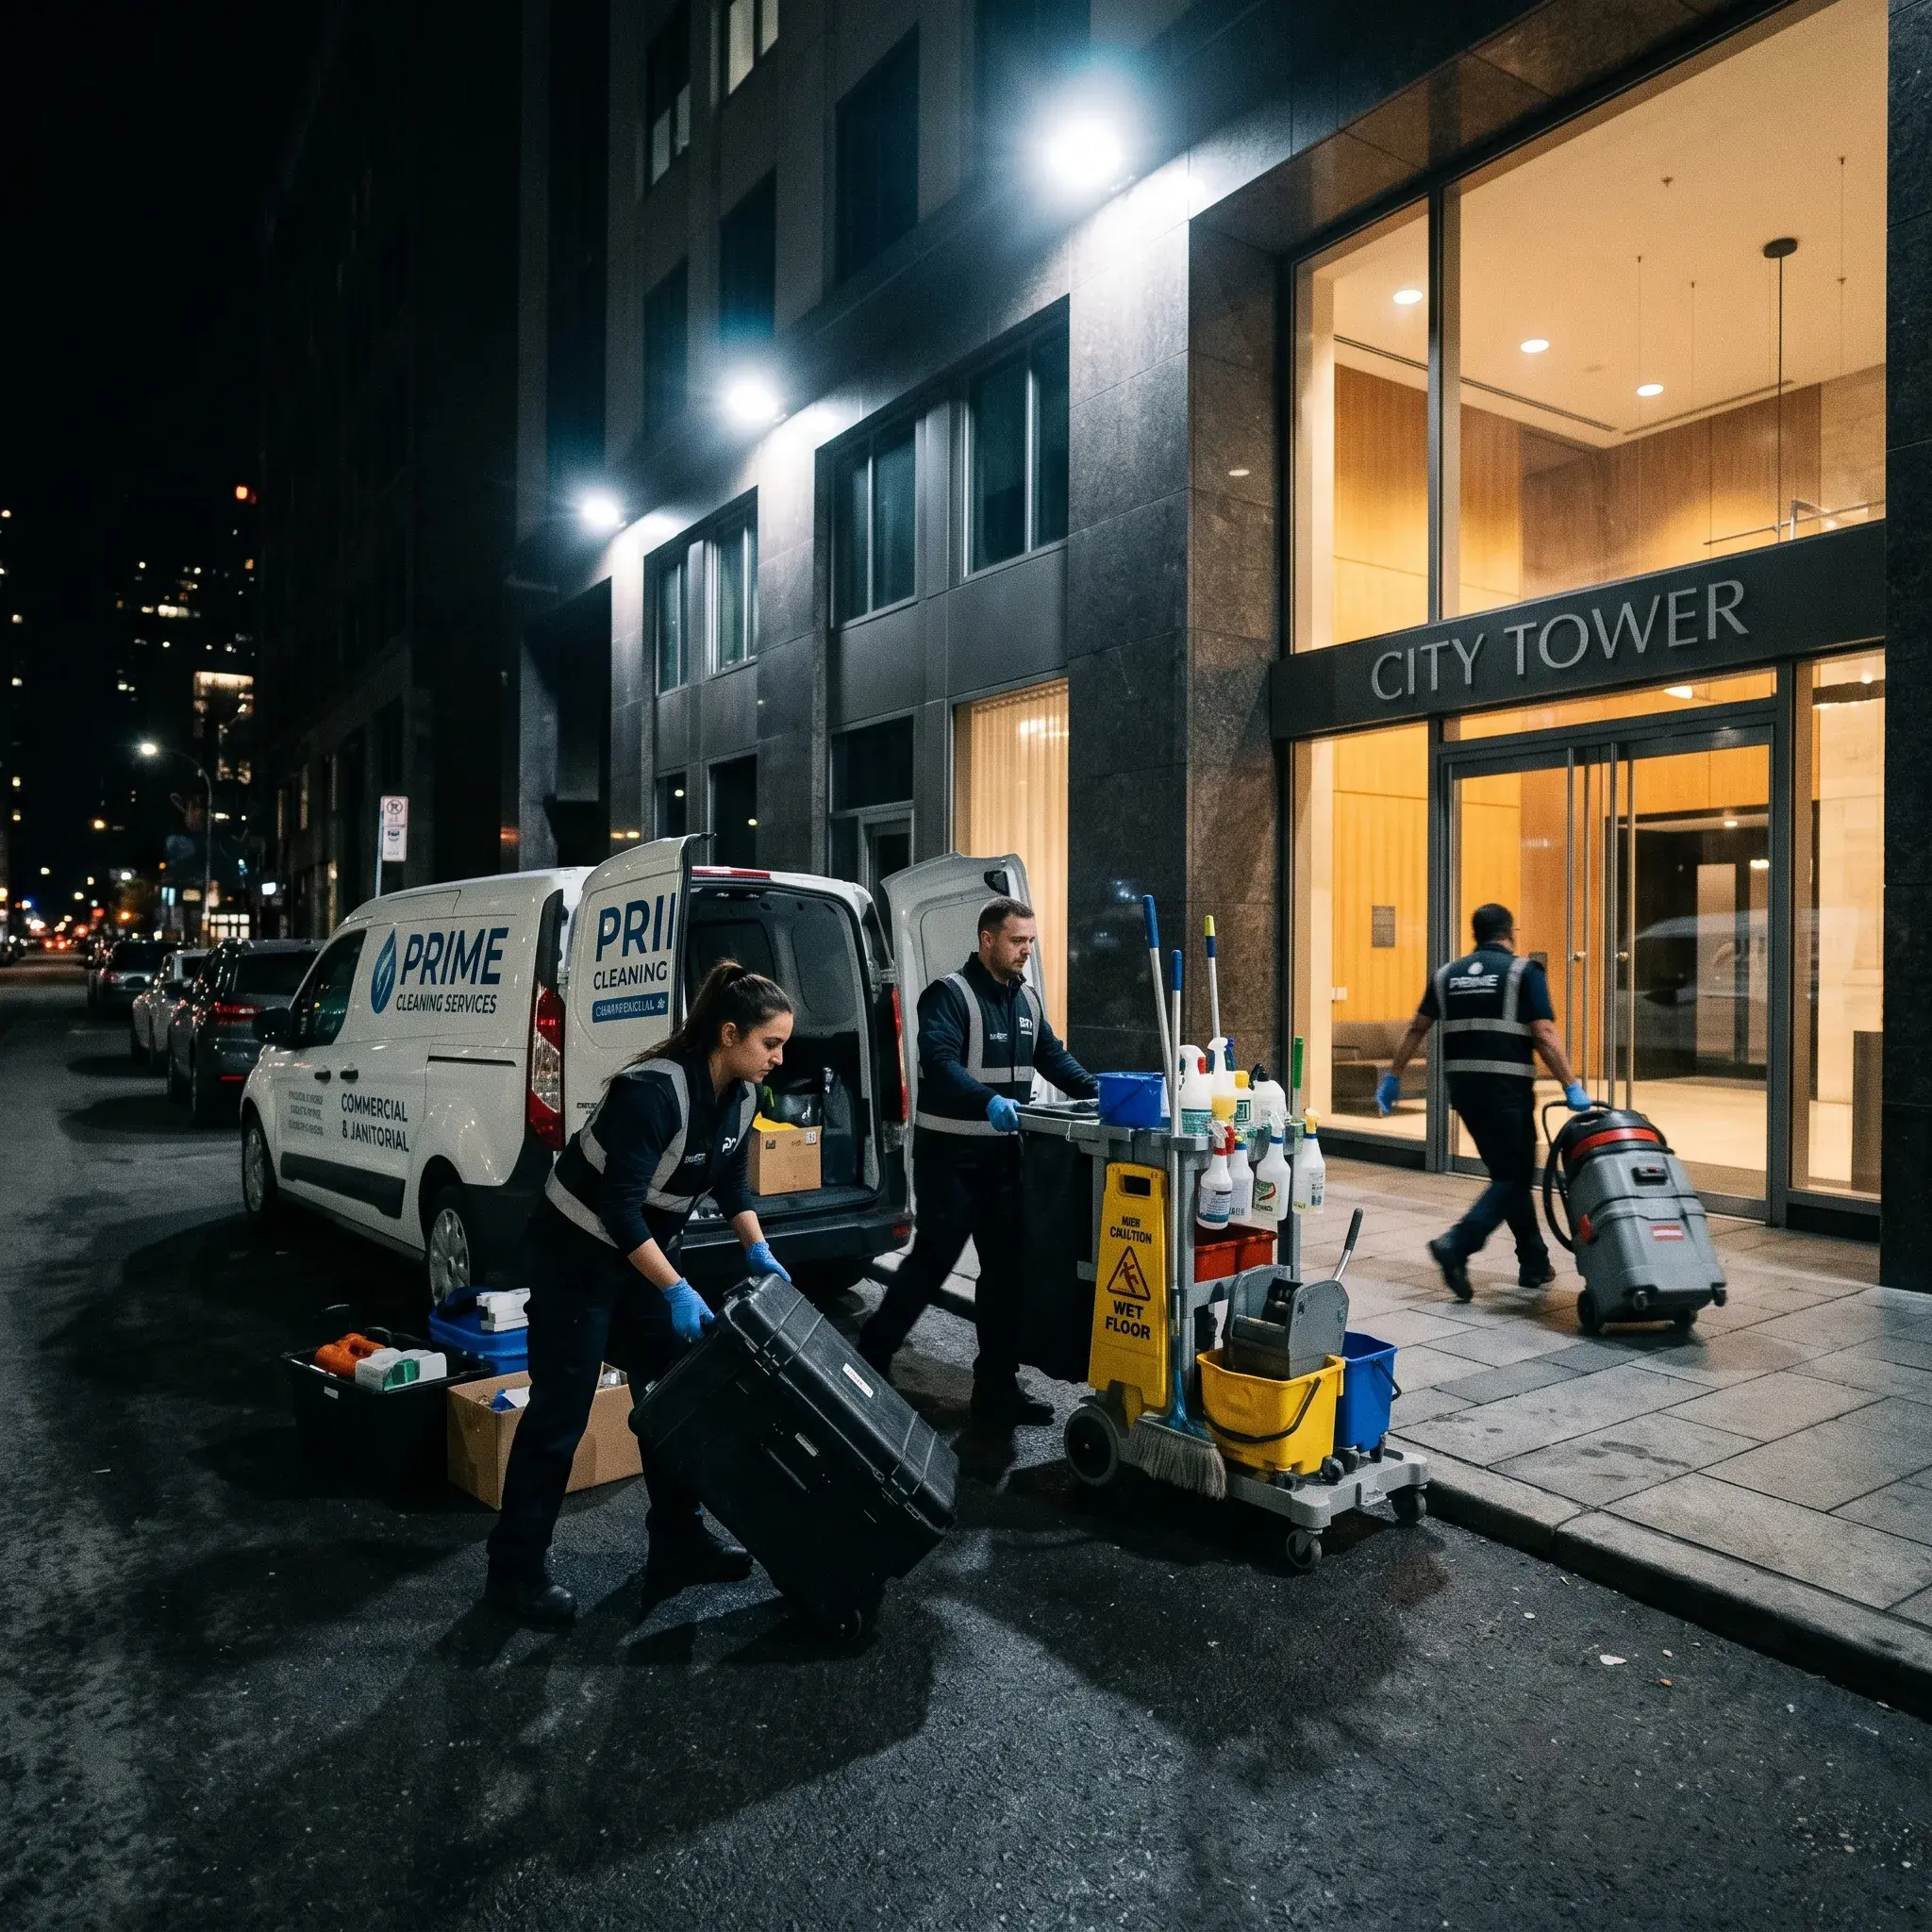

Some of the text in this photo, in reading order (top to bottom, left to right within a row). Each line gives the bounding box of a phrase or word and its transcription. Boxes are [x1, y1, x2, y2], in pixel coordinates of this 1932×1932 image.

[1371, 579, 1750, 701] CITY TOWER
[399, 926, 509, 986] PRIME
[592, 960, 668, 991] CLEANING
[396, 993, 498, 1014] CLEANING SERVICES
[341, 1092, 408, 1123] COMMERCIAL
[350, 1121, 409, 1153] JANITORIAL
[1113, 1300, 1143, 1321] WET
[1105, 1315, 1151, 1341] FLOOR
